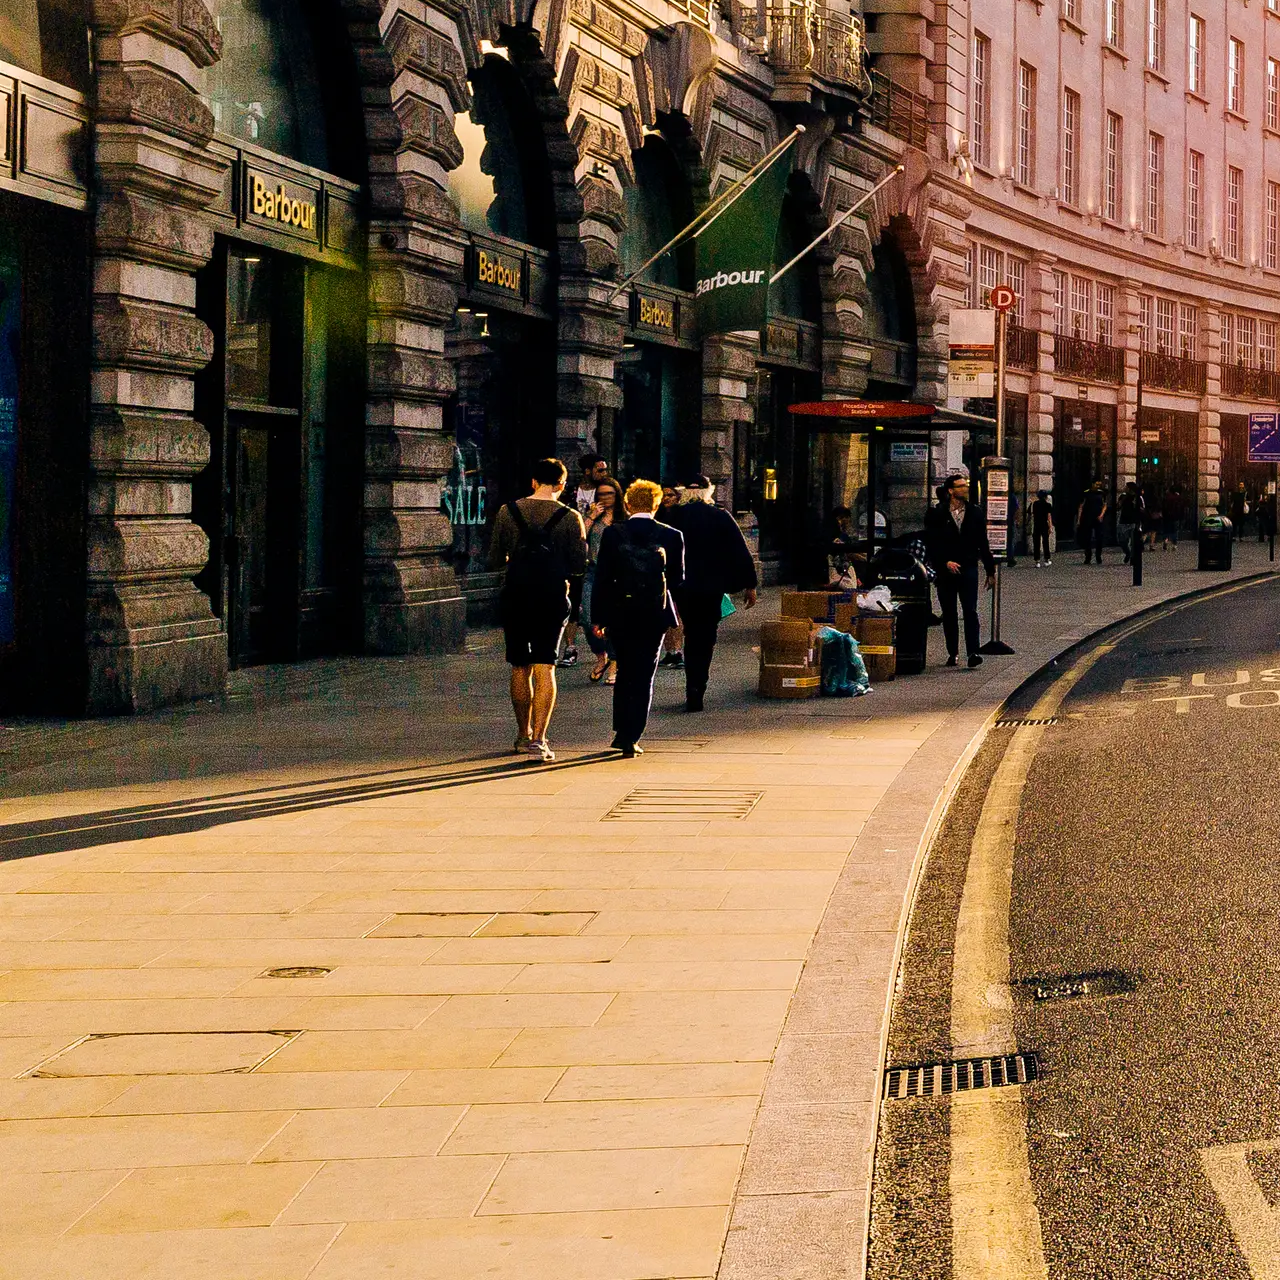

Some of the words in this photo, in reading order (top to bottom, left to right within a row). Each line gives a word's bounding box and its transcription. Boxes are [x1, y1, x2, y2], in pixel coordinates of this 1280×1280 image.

[253, 175, 316, 230] Barbour
[479, 251, 521, 290] Barbour
[640, 297, 673, 328] Barbour
[997, 291, 1012, 306] D
